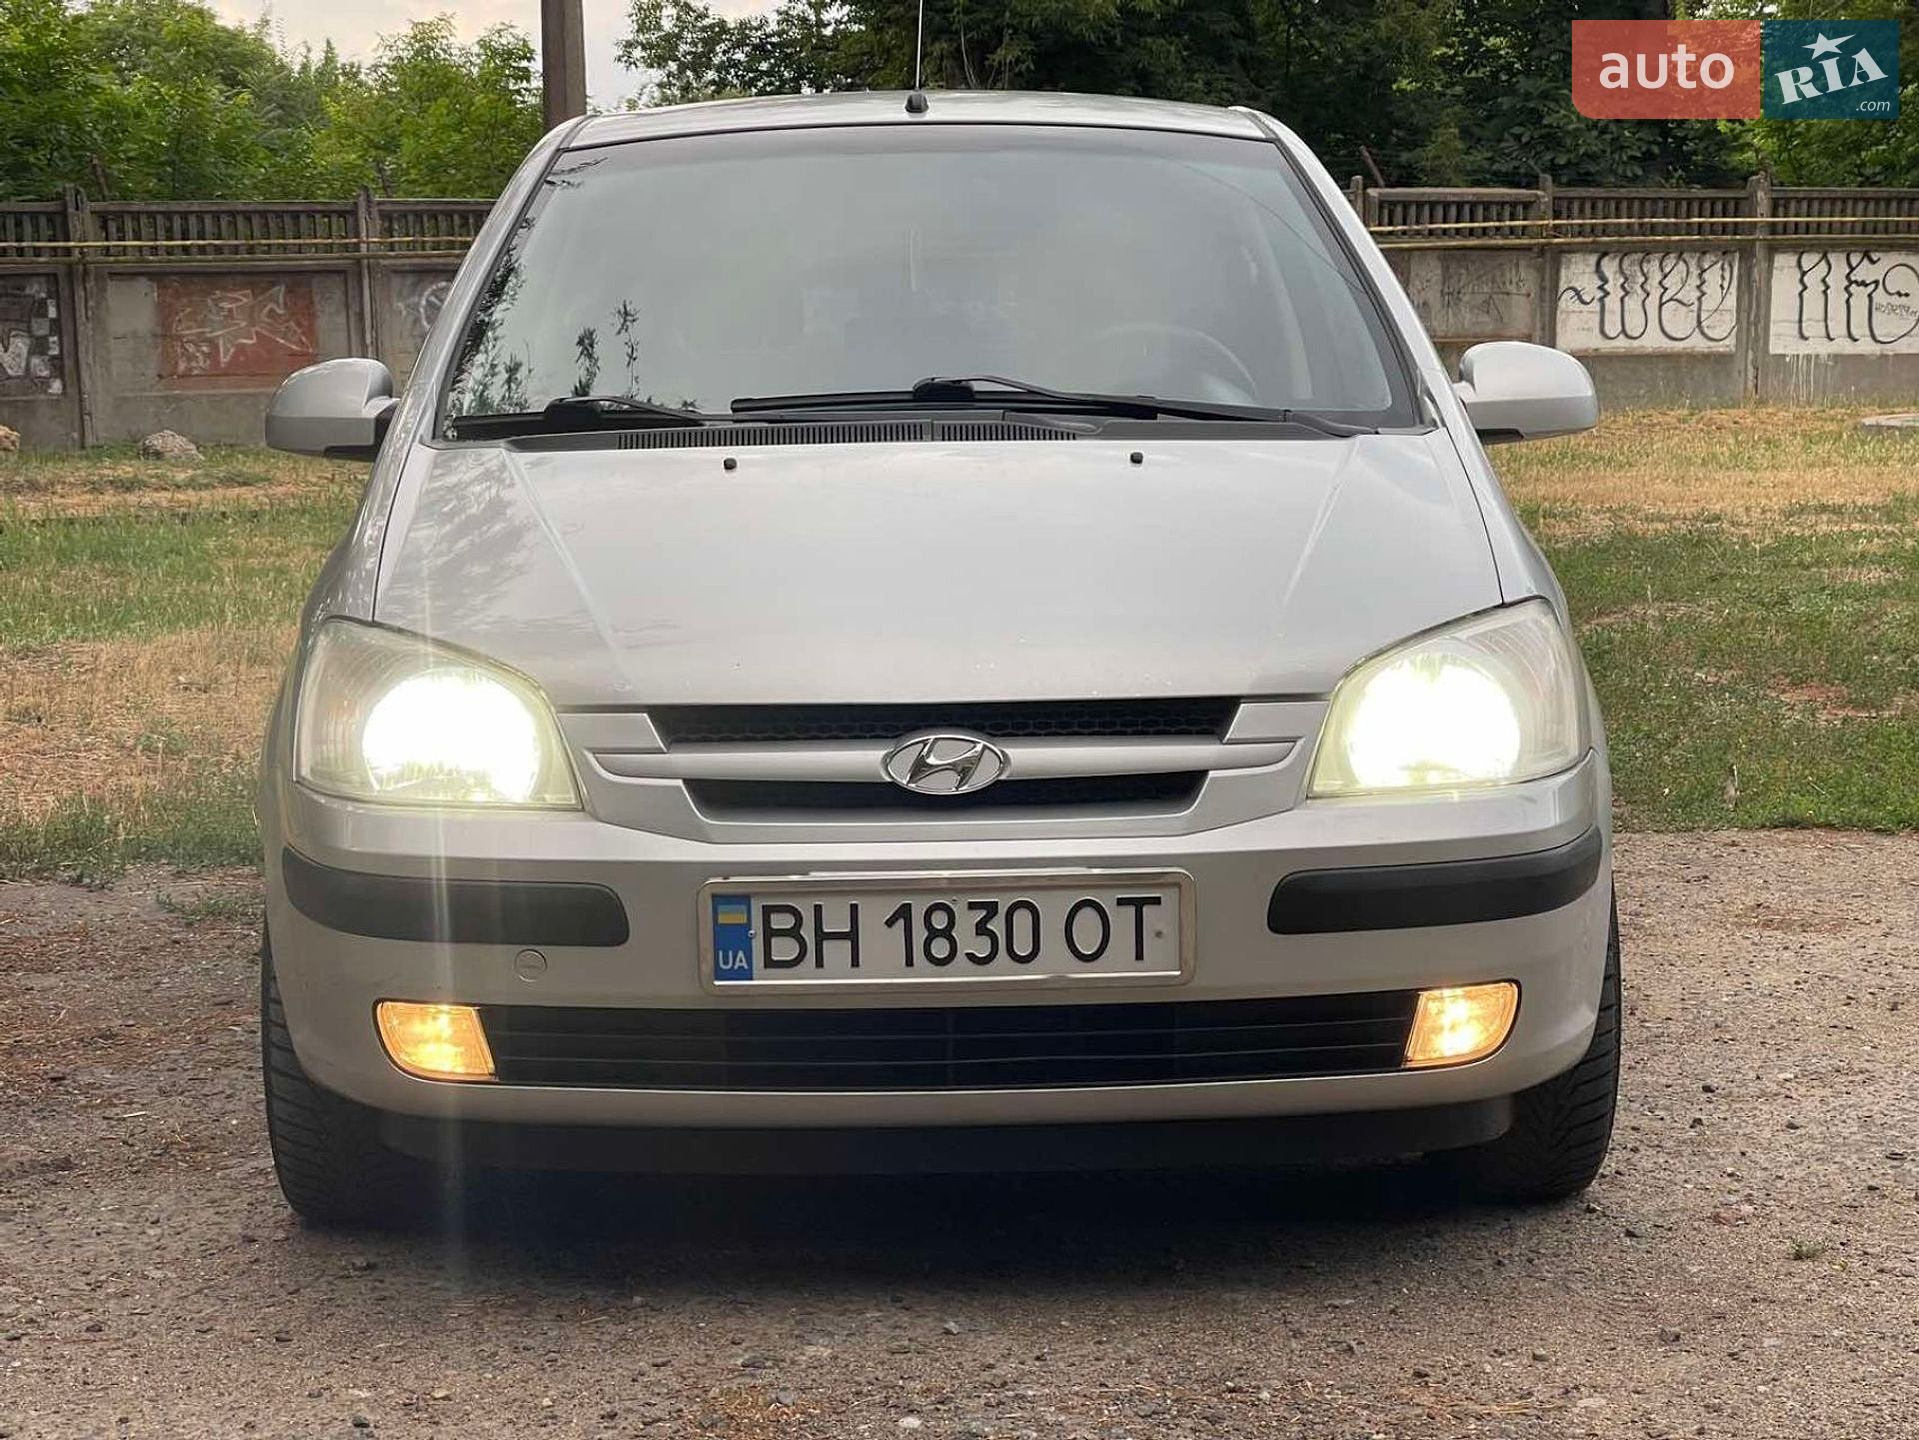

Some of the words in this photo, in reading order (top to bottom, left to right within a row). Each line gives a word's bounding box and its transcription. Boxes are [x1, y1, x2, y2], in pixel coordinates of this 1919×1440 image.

[762, 903, 860, 969] BH
[884, 900, 1041, 967] 1830
[1064, 896, 1162, 963] OT
[718, 951, 748, 970] UA
